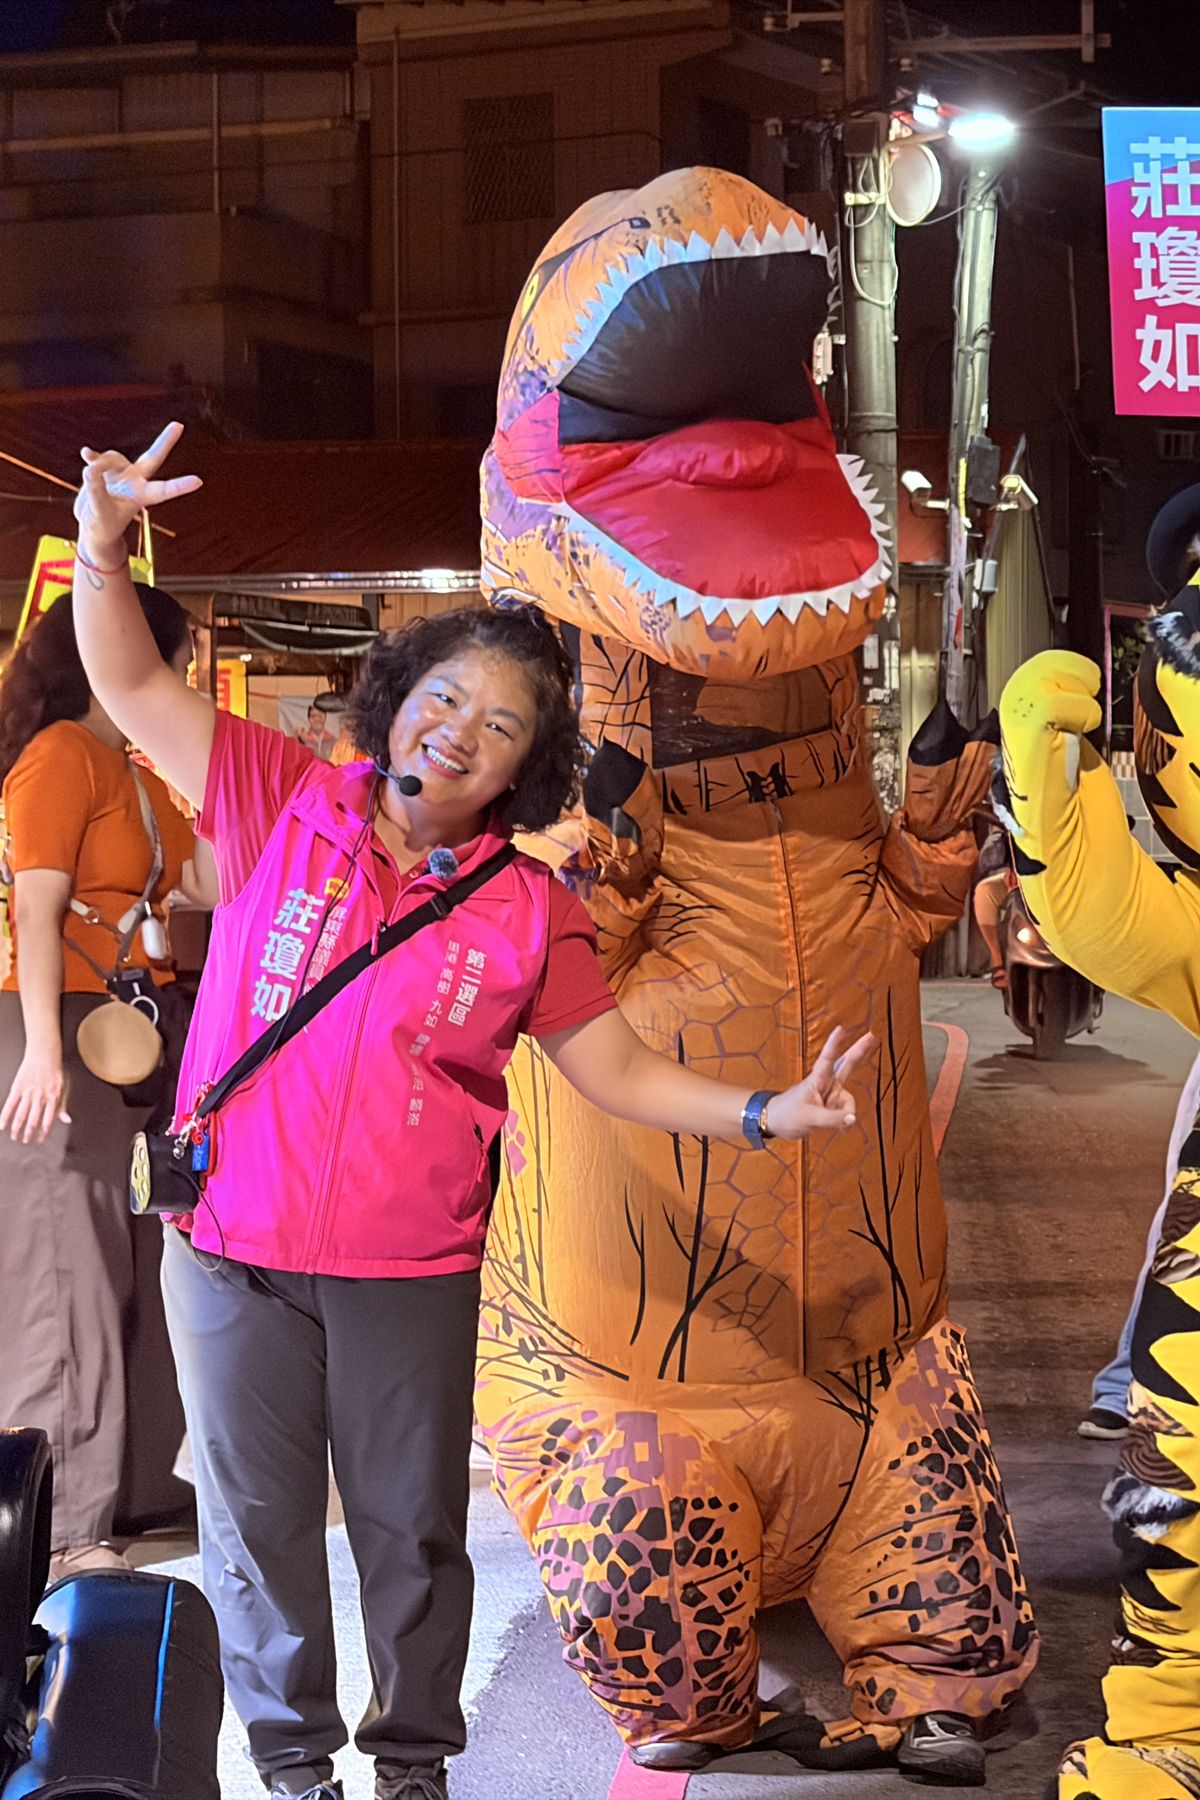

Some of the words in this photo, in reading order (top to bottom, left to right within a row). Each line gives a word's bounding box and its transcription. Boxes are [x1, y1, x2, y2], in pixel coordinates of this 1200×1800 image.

[251, 888, 326, 1022] 莊瓊如
[447, 948, 487, 1027] 第二選區
